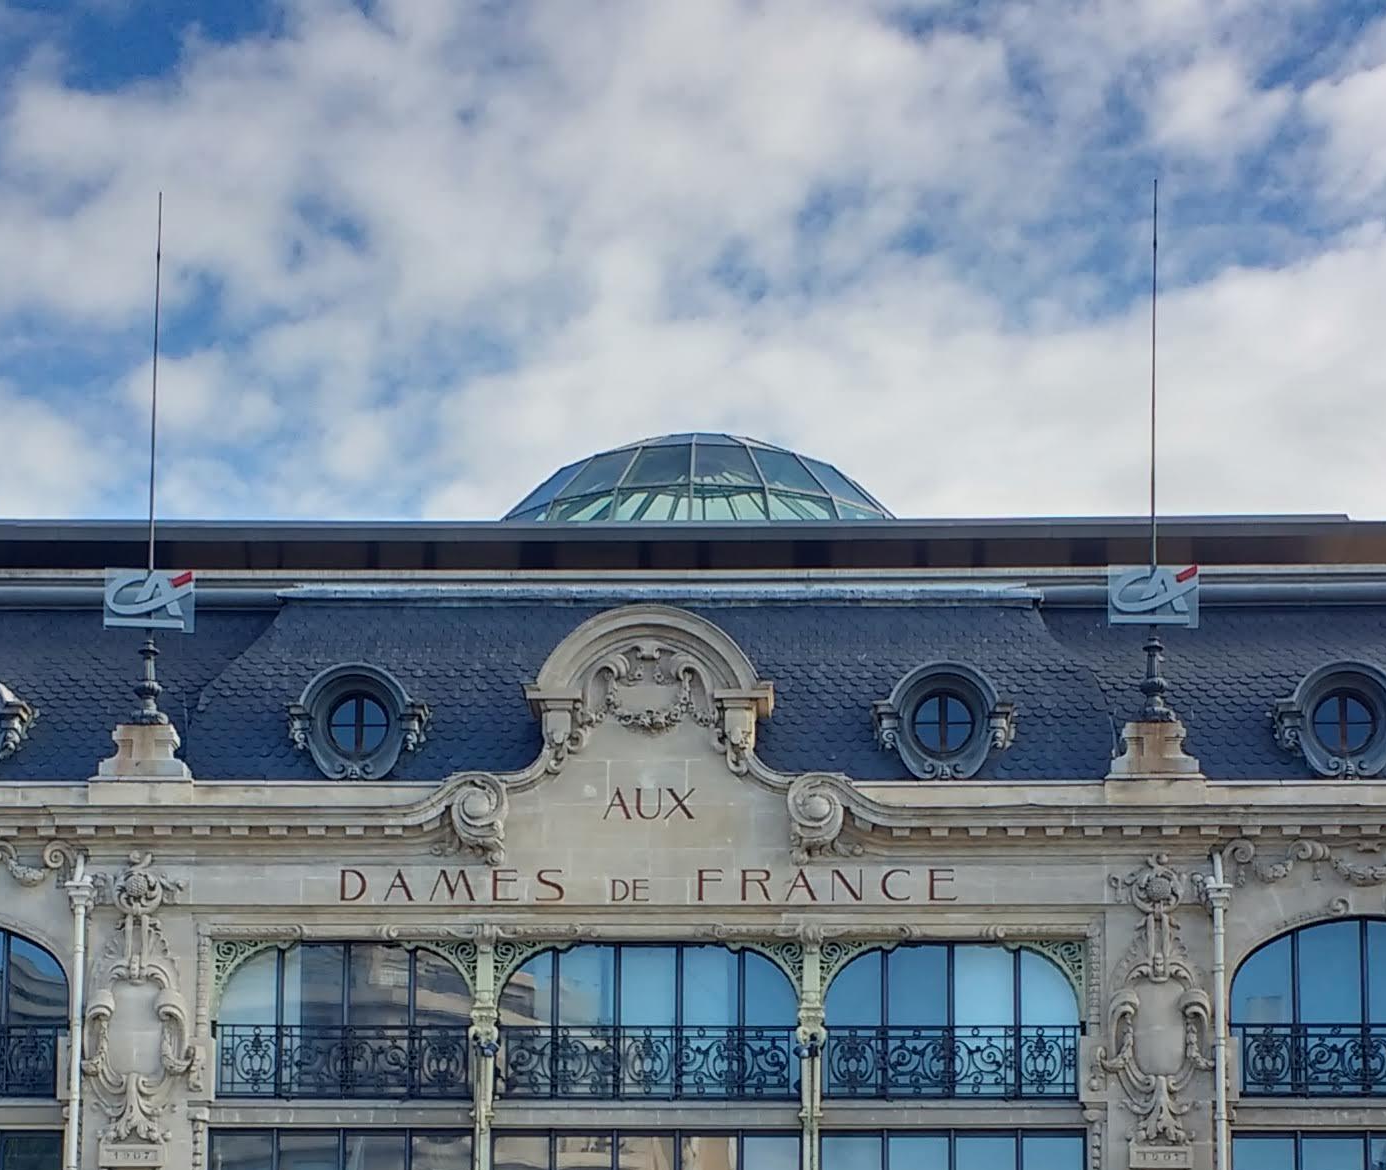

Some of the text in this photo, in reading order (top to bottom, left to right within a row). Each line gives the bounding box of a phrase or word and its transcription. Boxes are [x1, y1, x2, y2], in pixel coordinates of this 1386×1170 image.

[602, 786, 696, 820] AUX
[339, 868, 959, 902] DAMES DE FRANCE
